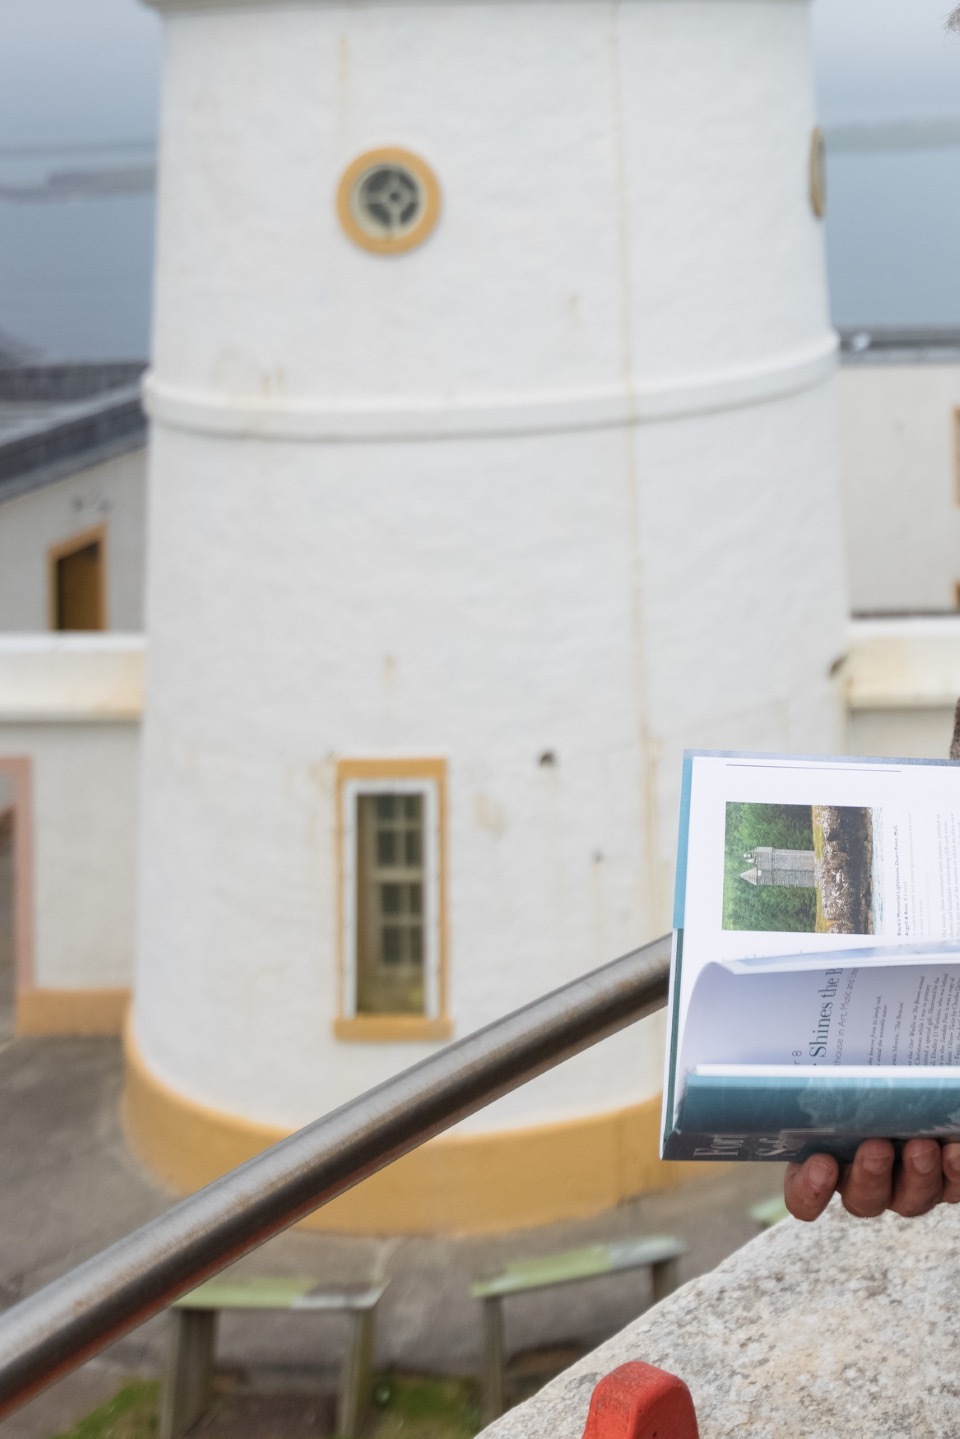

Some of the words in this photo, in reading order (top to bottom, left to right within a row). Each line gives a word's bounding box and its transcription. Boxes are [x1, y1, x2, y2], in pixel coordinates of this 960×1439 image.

[818, 978, 840, 998] the
[808, 1002, 834, 1058] Shines
[832, 1038, 844, 1066] thouse
